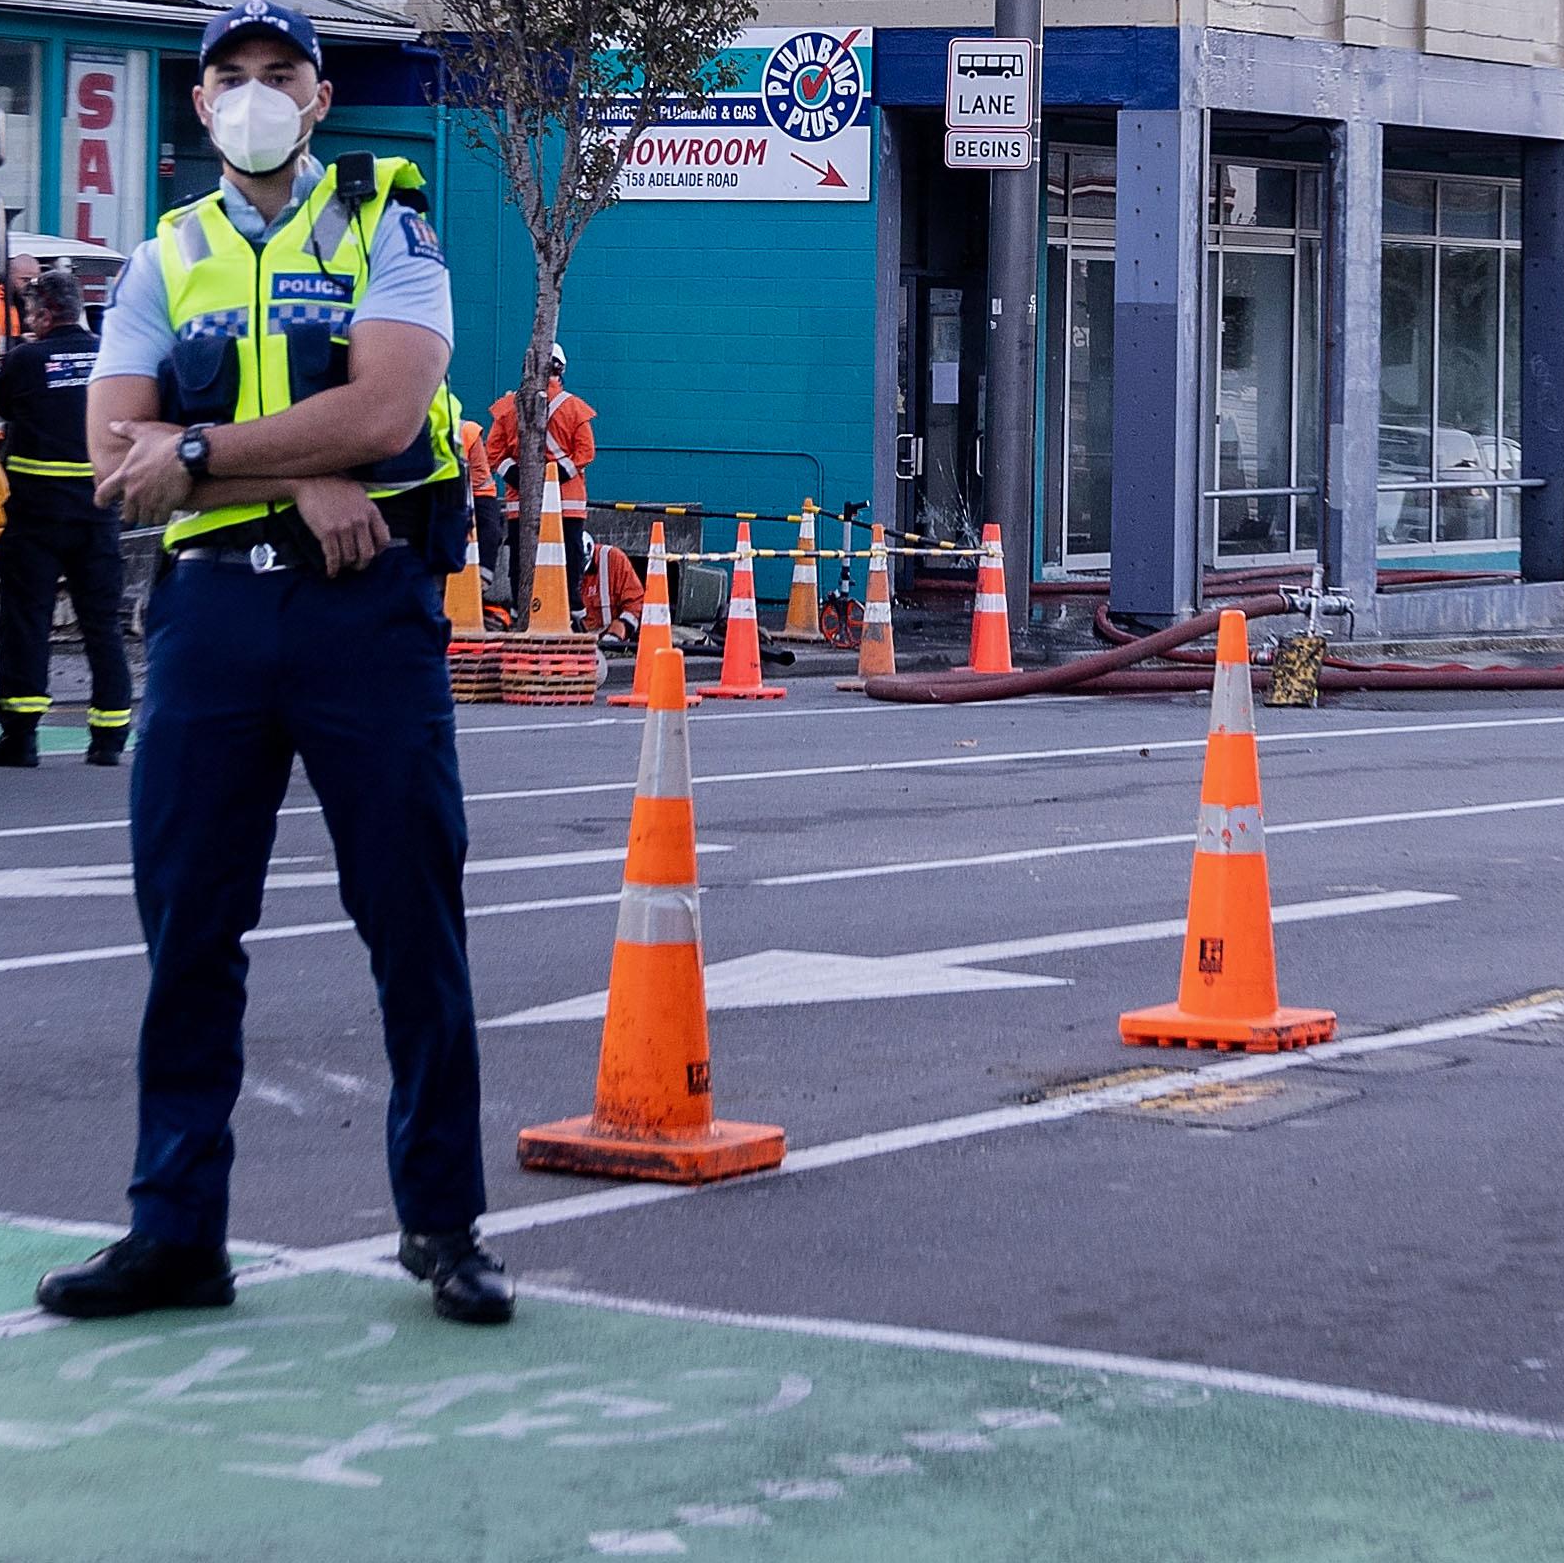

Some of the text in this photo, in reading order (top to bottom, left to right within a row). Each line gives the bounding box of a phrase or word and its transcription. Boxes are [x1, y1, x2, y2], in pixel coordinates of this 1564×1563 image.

[767, 35, 857, 96] PLUMBING
[721, 105, 731, 120] &
[733, 105, 757, 120] GAS
[958, 95, 1016, 114] LANE
[784, 105, 839, 138] PLUS
[955, 140, 1021, 158] BEGINS
[625, 172, 739, 187] 158 ADELAIDE ROAD
